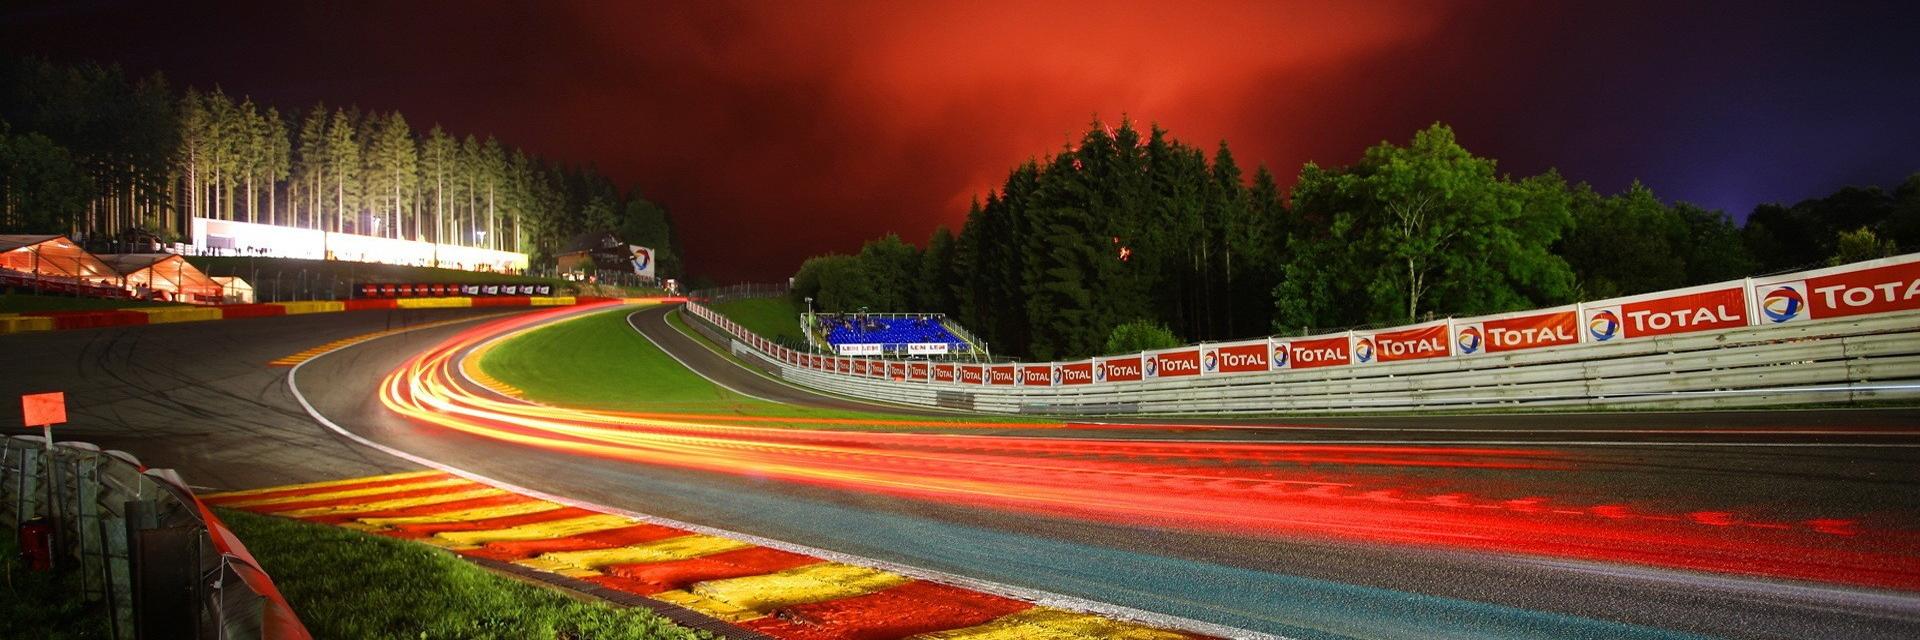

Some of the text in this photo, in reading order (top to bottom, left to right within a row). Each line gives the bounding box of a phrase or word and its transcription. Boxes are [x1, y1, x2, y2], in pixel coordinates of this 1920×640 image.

[1627, 304, 1741, 332] TOTAL
[1487, 325, 1574, 346] TOTAL
[1378, 337, 1446, 356] TOTAL
[1220, 352, 1267, 367] TOTAL
[1292, 346, 1348, 362] TOTAL
[1107, 364, 1140, 377] TOTAL
[1159, 357, 1199, 372] TOTAL
[891, 366, 905, 376] TOTAL
[911, 367, 927, 376] TOTAL
[936, 367, 953, 378] TOTAL
[962, 369, 982, 381] TOTAL
[992, 370, 1013, 381] TOTAL
[1025, 370, 1050, 382] TOTAL
[1063, 368, 1092, 380] TOTAL
